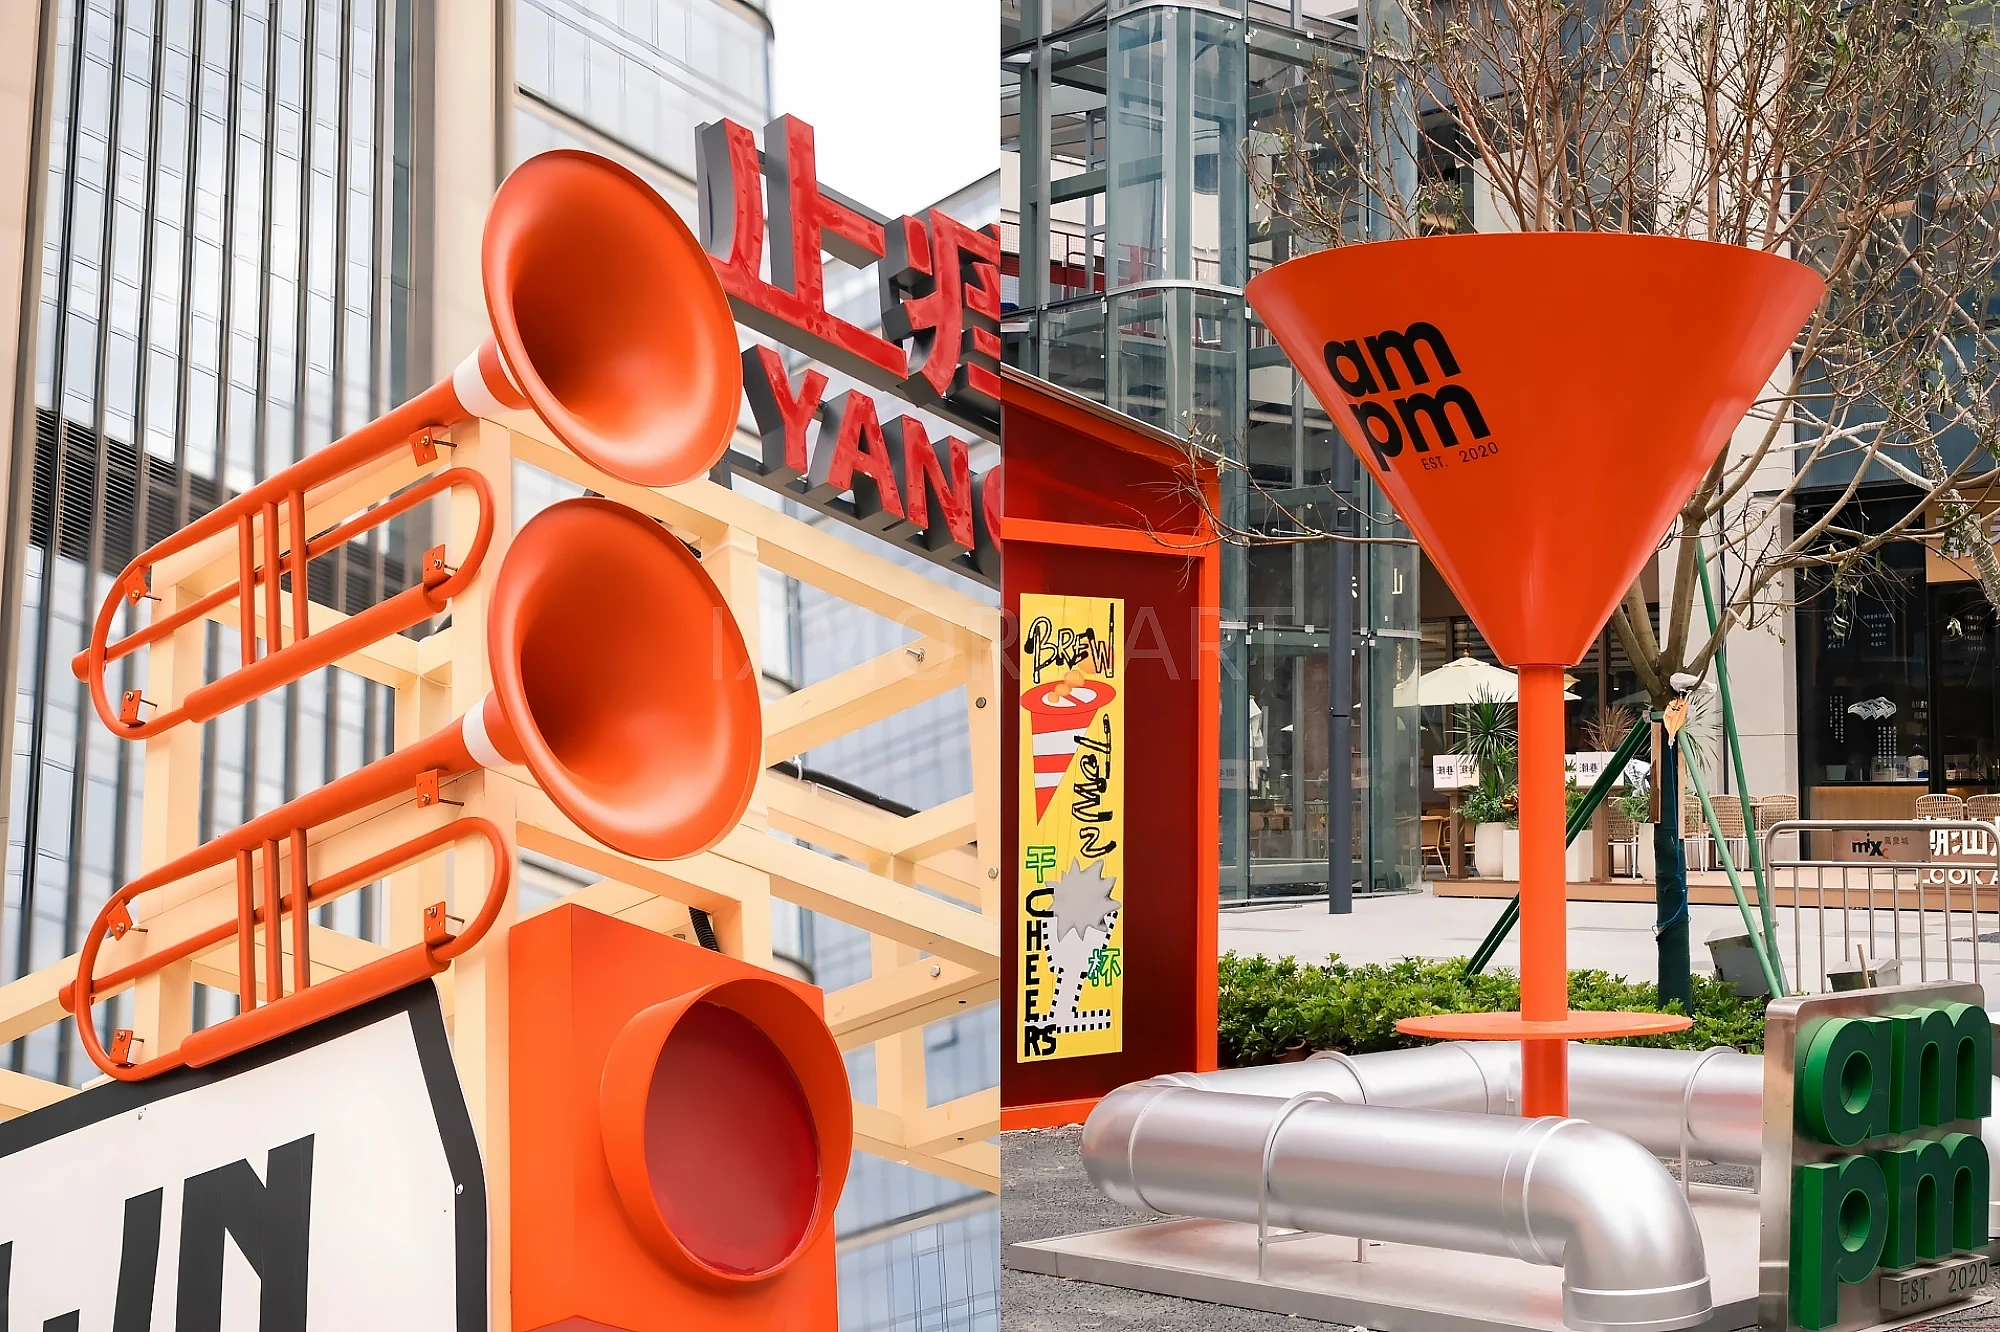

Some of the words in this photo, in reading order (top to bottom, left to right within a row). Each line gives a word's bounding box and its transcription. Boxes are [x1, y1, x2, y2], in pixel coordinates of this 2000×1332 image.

[1323, 321, 1462, 398] am
[743, 343, 1000, 552] YAN
[1348, 384, 1492, 472] pm
[1421, 455, 1448, 471] EST.
[1458, 441, 1499, 463] 2020
[1024, 603, 1115, 684] BREW
[1072, 713, 1117, 858] TOWN
[1025, 846, 1056, 883] 干
[1024, 887, 1057, 1058] CHEERS
[1087, 948, 1122, 987] 杯
[1803, 1003, 1992, 1147] am
[1802, 1132, 1990, 1331] pm
[1901, 1278, 1932, 1307] EST.
[1948, 1265, 1988, 1294] 2020
